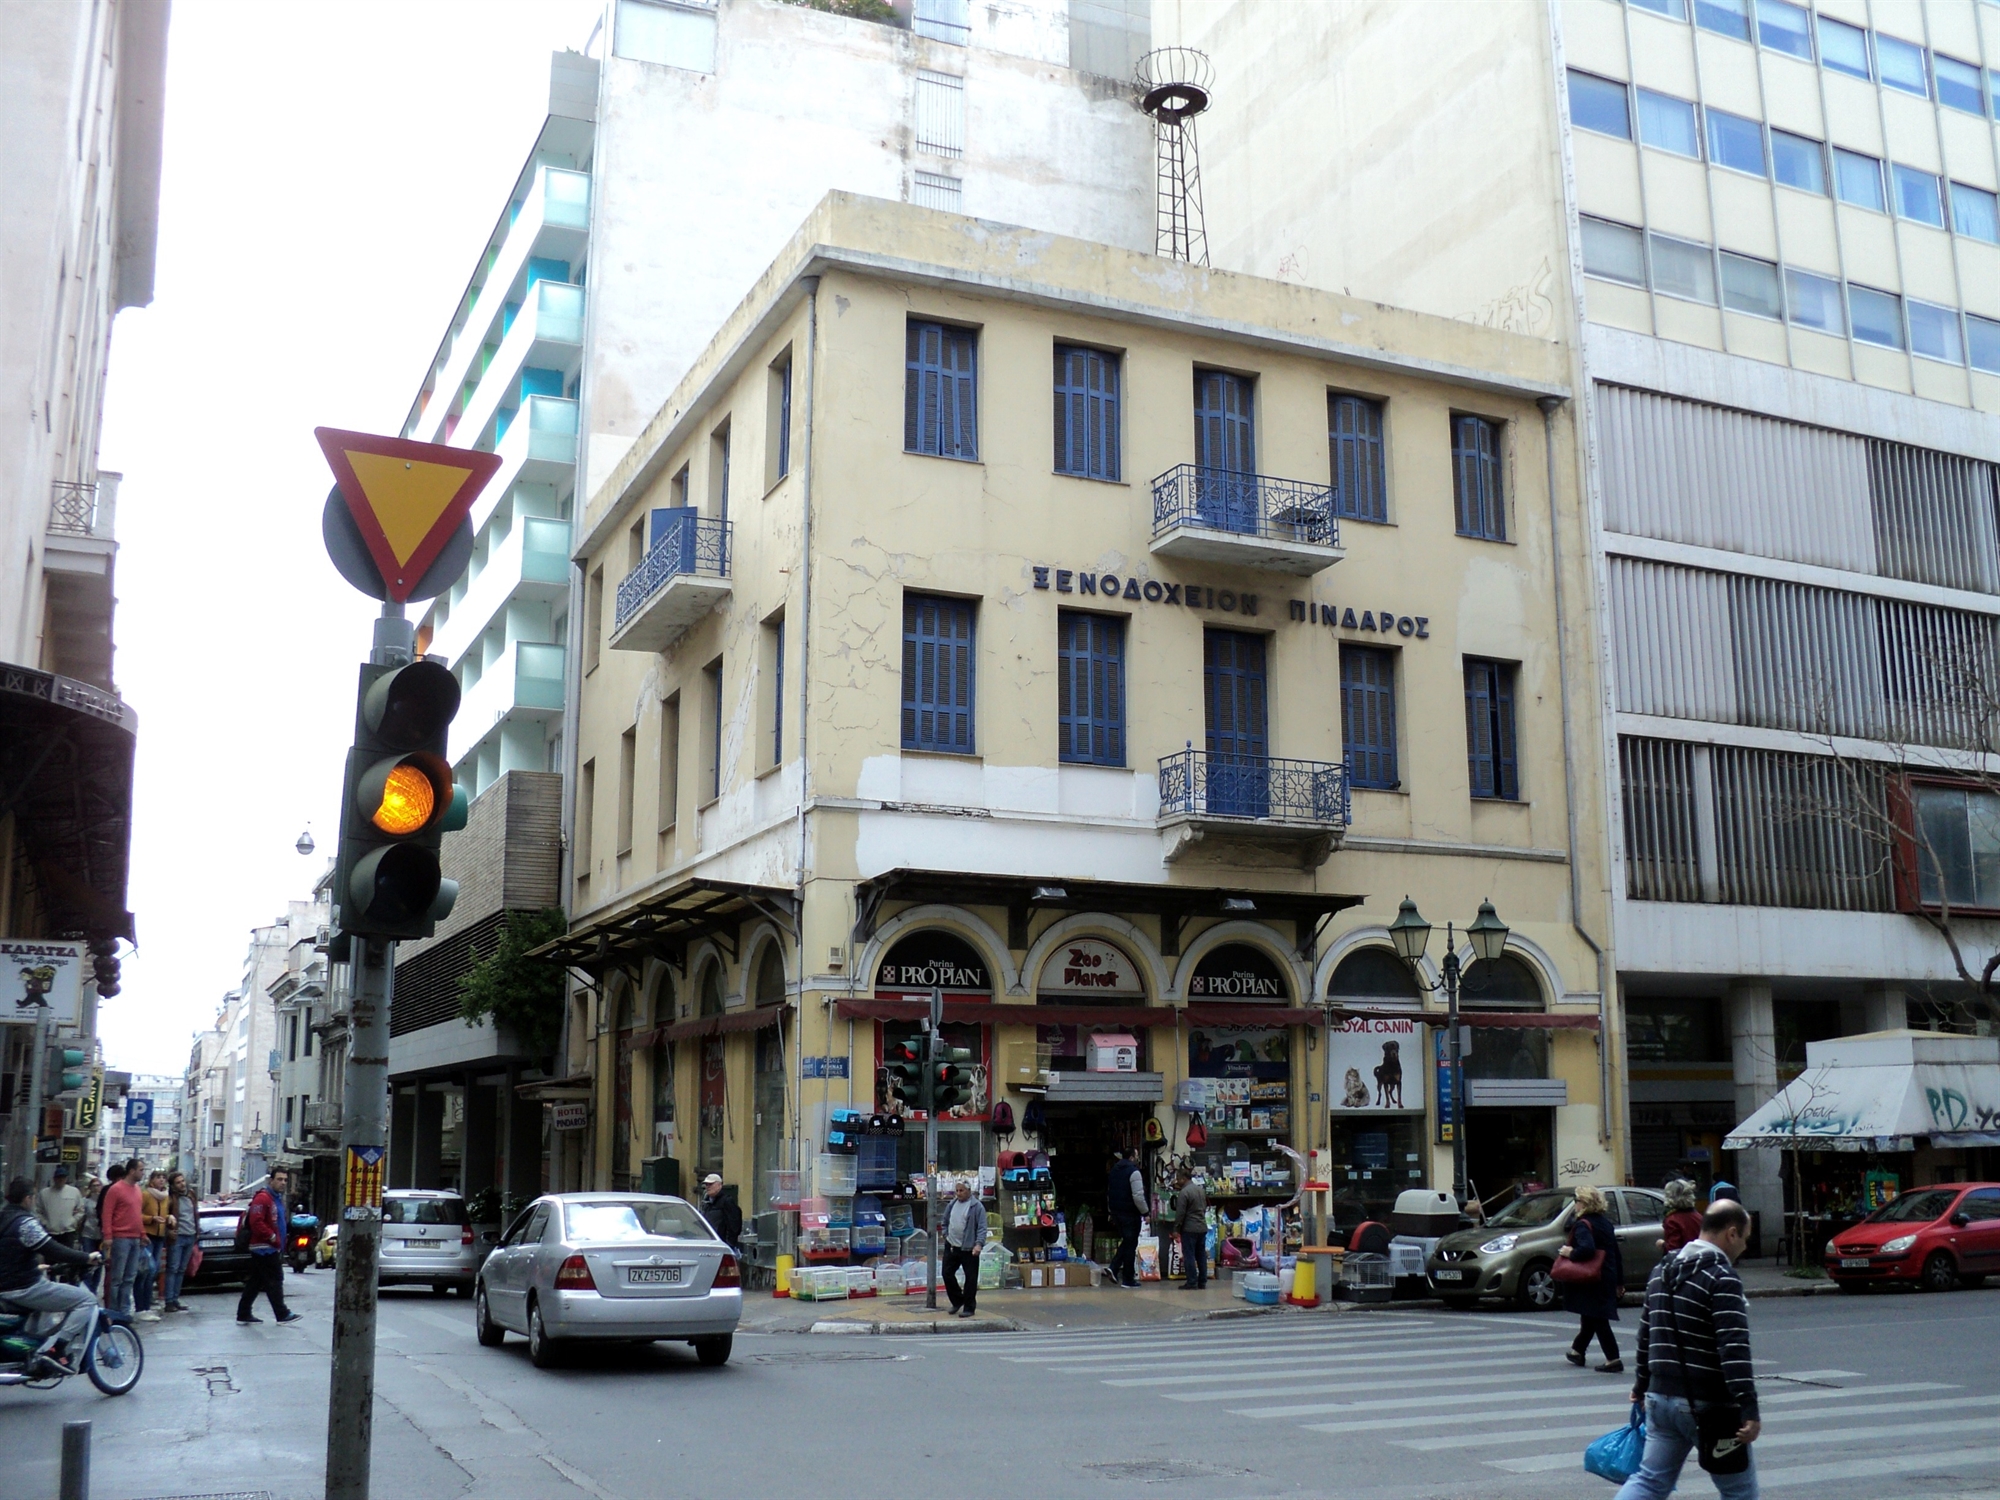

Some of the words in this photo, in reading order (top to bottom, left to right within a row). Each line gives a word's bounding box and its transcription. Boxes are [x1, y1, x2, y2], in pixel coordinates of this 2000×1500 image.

[1032, 565, 1258, 617] ΞΕΝΟΔΟΧΕΙΟΝ
[1289, 598, 1429, 639] ΠΙΝΔΑΡΟΣ
[929, 959, 954, 968] Purina
[1069, 949, 1101, 967] Zoo
[900, 966, 937, 985] PRO
[939, 967, 983, 986] PLAN
[1064, 968, 1119, 988] Planet
[1232, 970, 1254, 979] Purina
[1208, 976, 1241, 995] PRO
[1242, 977, 1279, 995] PLAN
[1374, 1020, 1414, 1034] CANIN
[132, 1101, 147, 1120] P
[557, 1108, 584, 1117] HOTEL
[1869, 1180, 1878, 1207] PARIS
